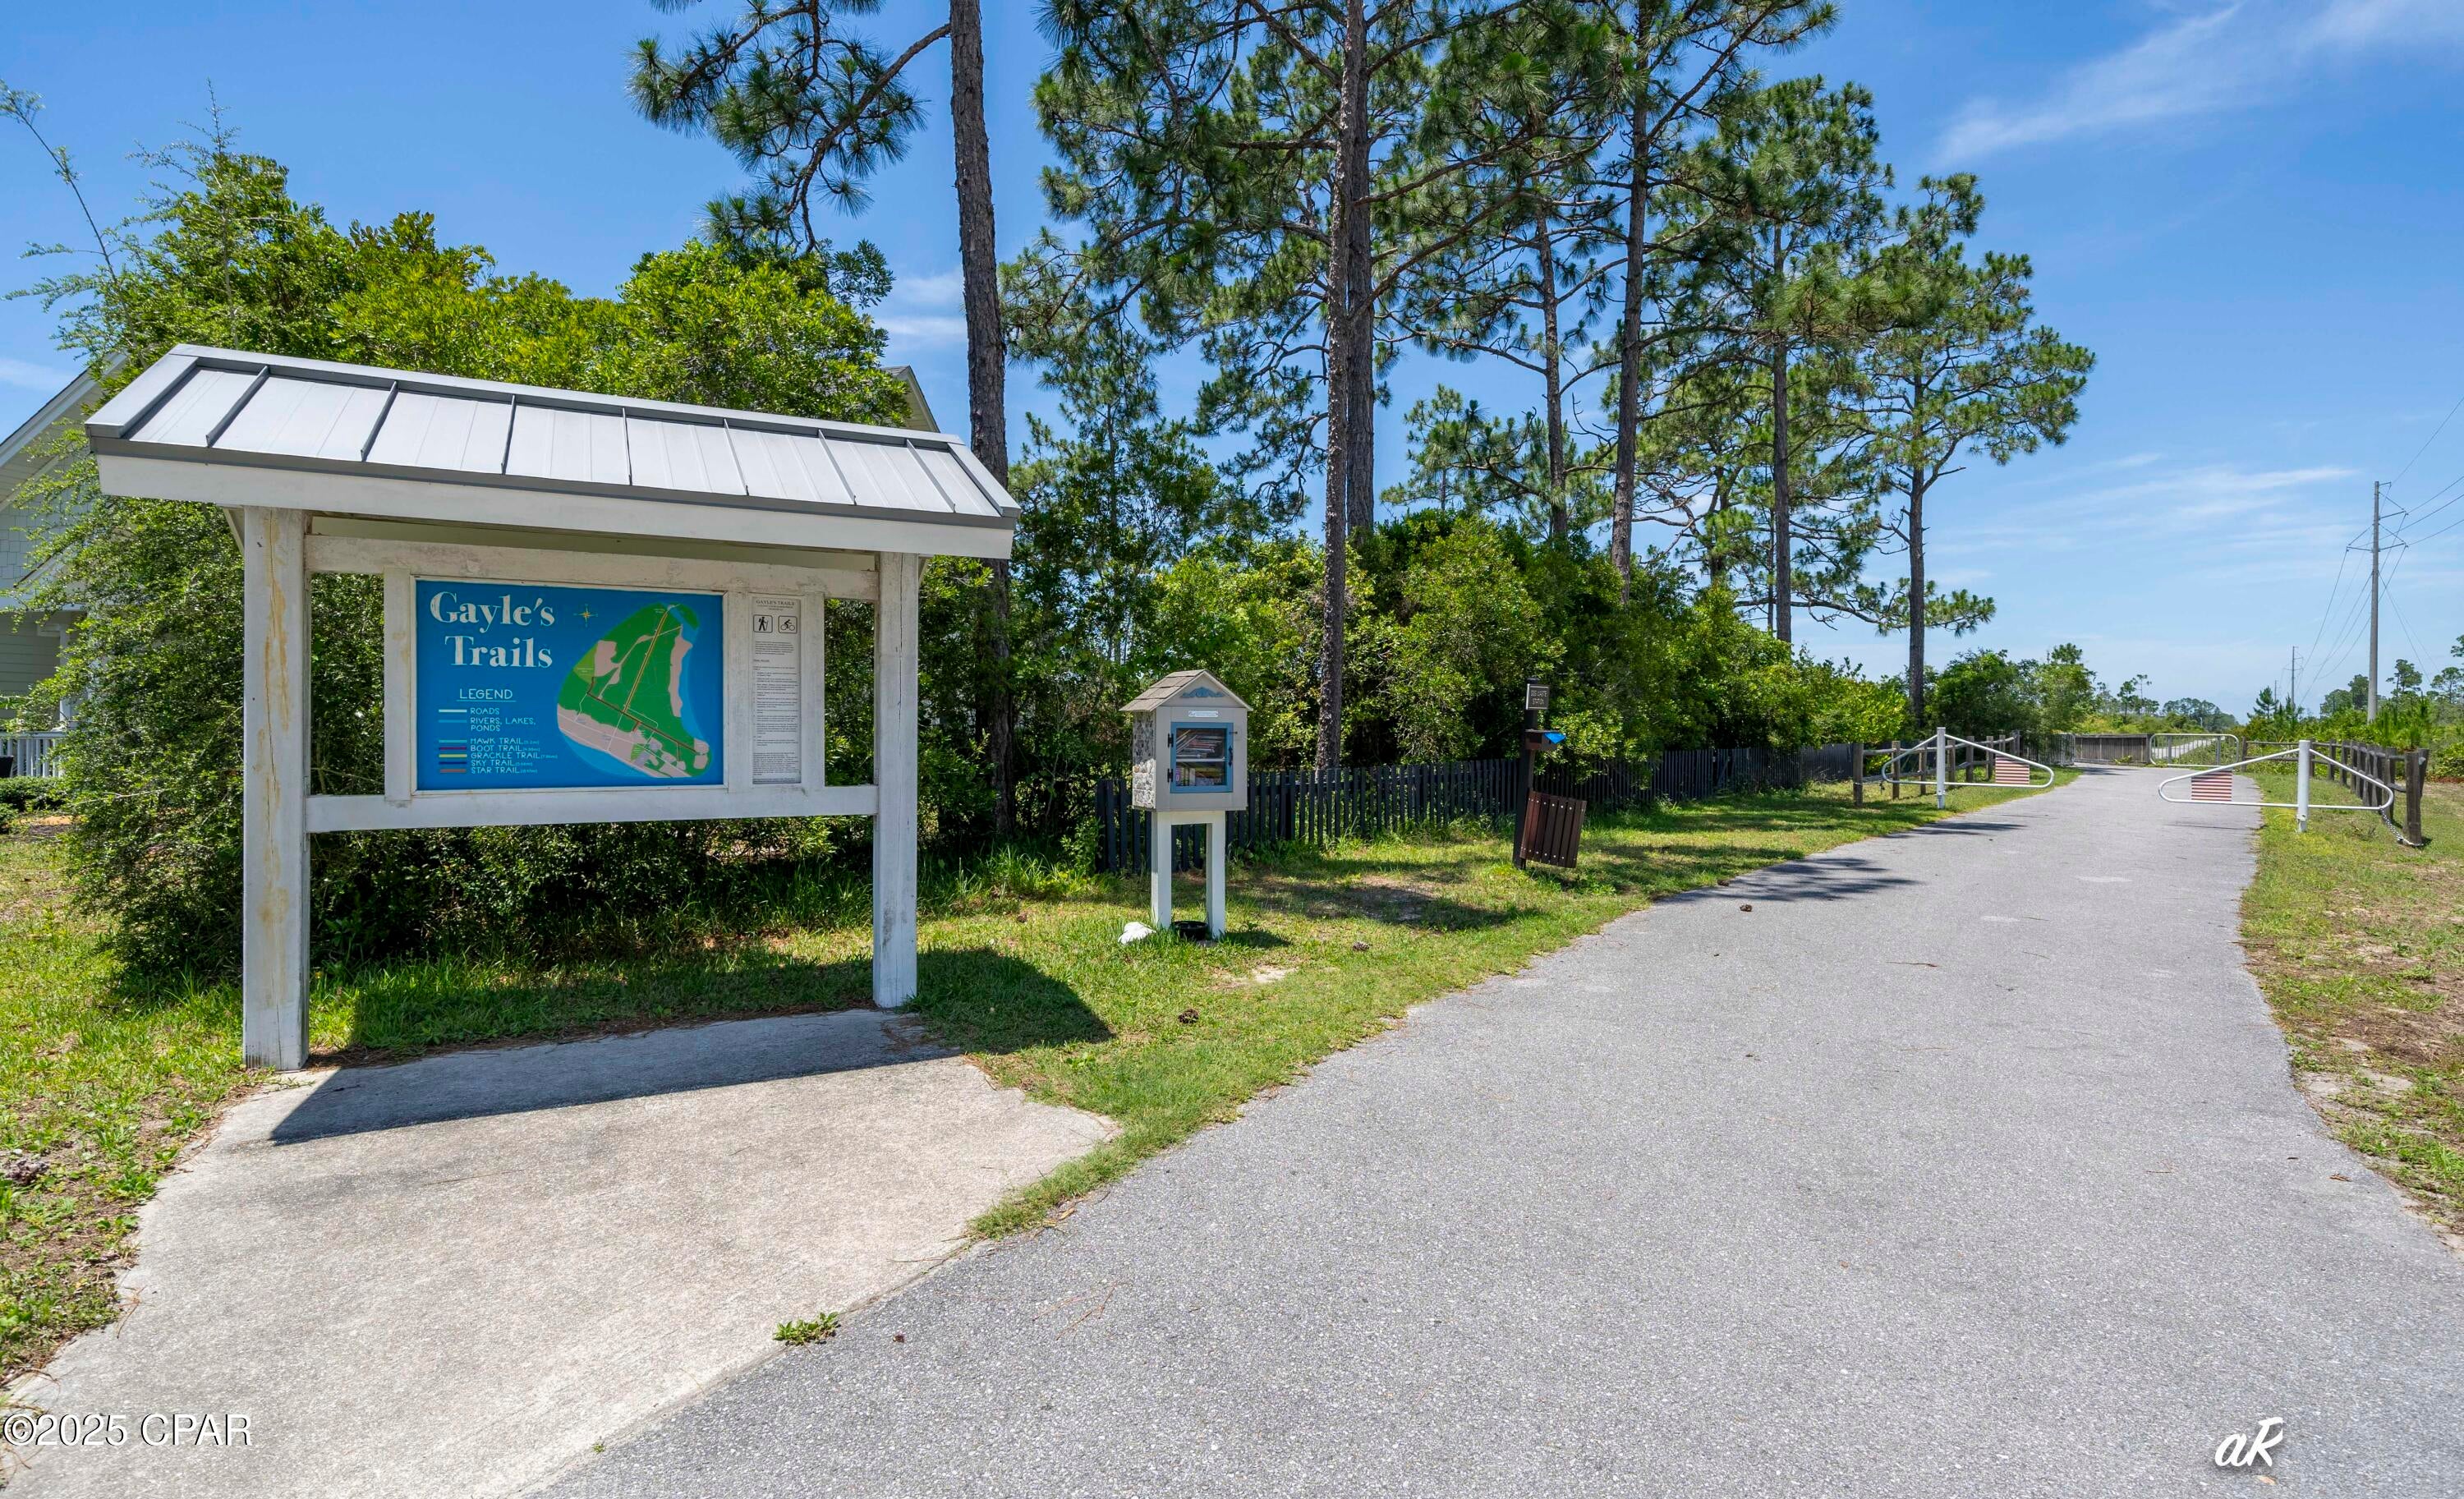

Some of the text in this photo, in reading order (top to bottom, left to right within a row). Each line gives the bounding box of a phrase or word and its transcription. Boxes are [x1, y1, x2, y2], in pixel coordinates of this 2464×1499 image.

[430, 591, 555, 633] Gayle's
[444, 635, 553, 669] Trails
[459, 688, 513, 700] LEGEND
[470, 707, 500, 715] ROADS
[470, 717, 536, 725] RIVERS, LAKES,
